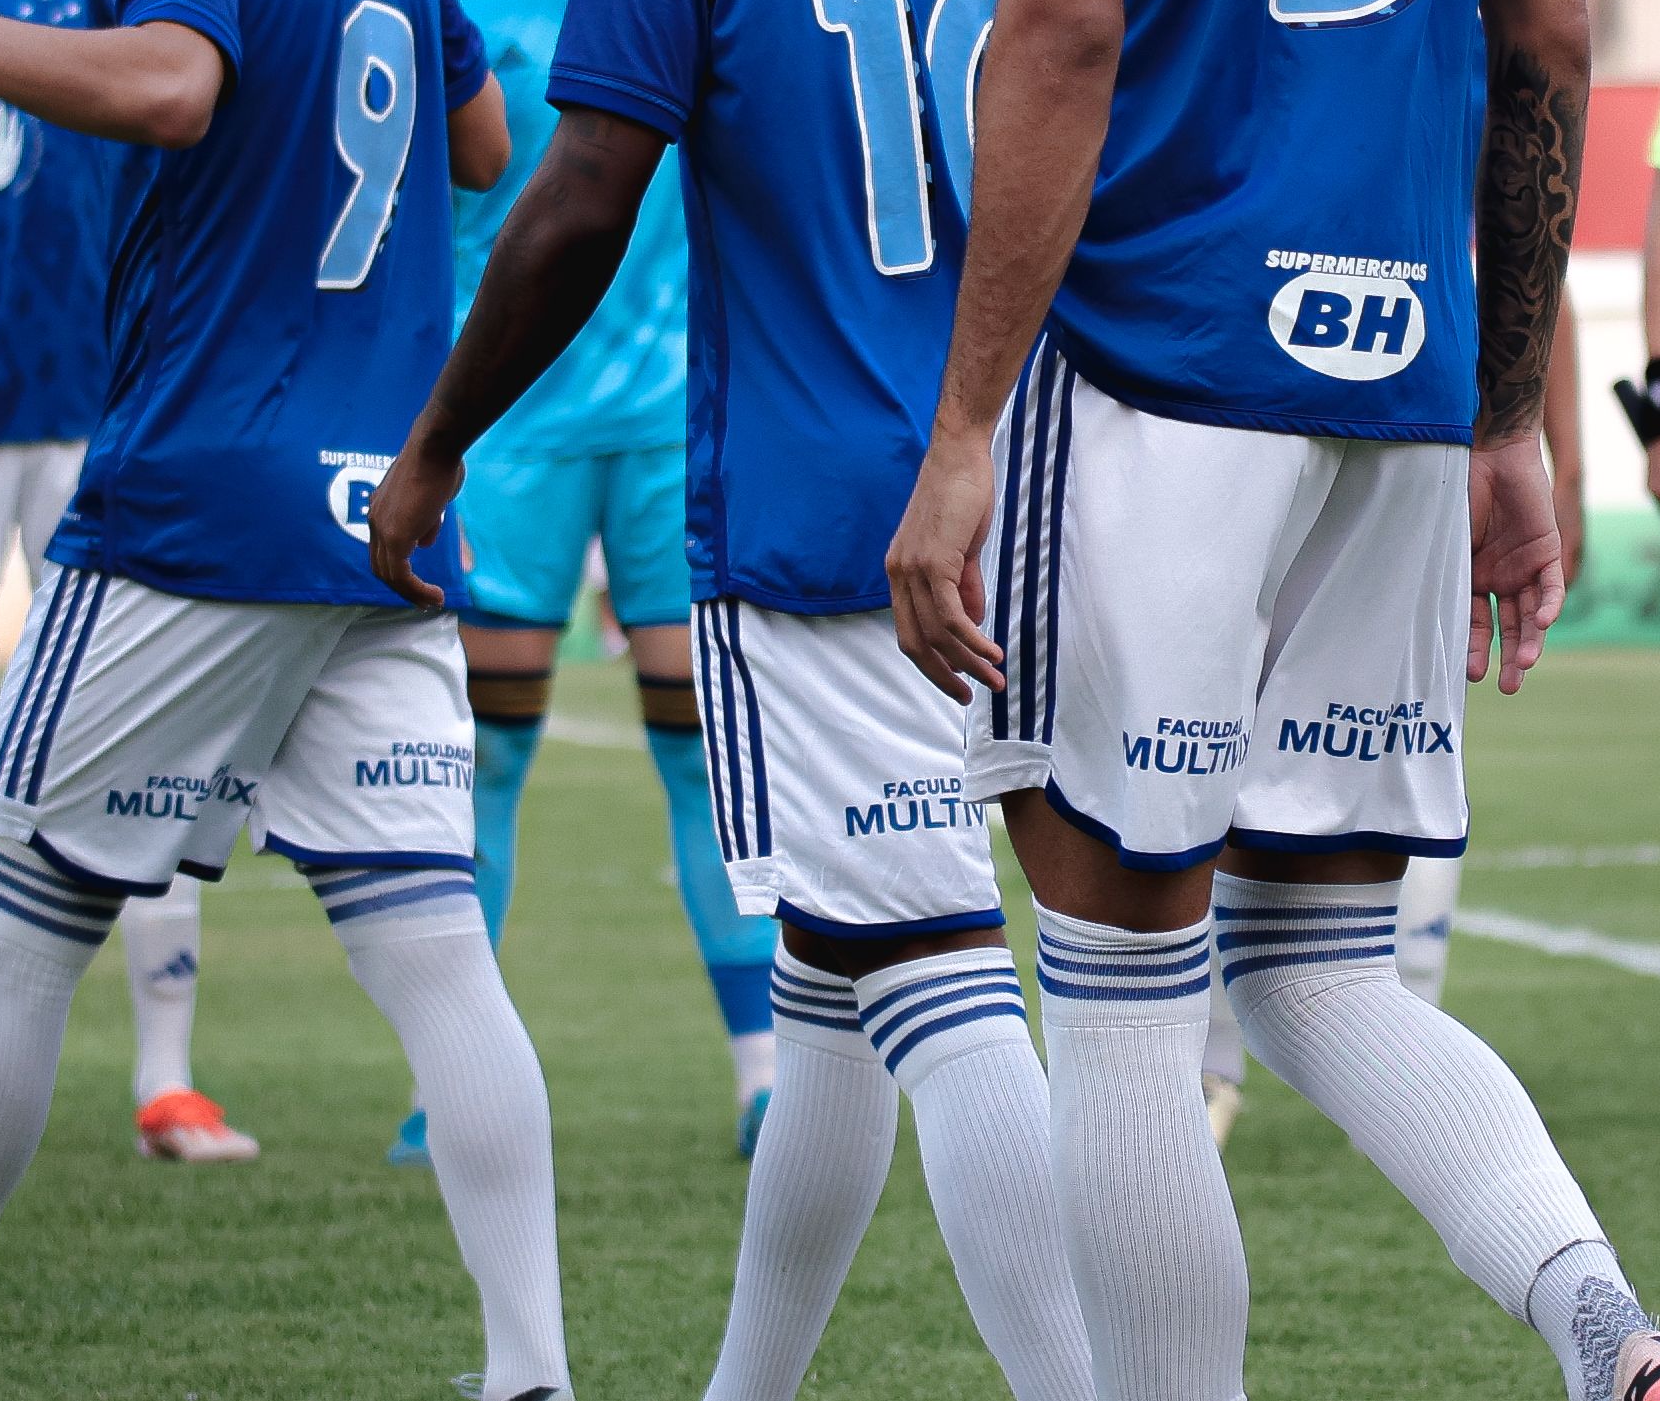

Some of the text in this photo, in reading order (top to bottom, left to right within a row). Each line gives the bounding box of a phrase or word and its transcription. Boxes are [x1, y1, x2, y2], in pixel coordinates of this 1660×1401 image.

[316, 0, 417, 290] 9
[1265, 250, 1428, 282] SUPERMERCADOS
[1288, 289, 1413, 356] BH
[347, 480, 377, 524] B
[883, 777, 963, 799] FACULD
